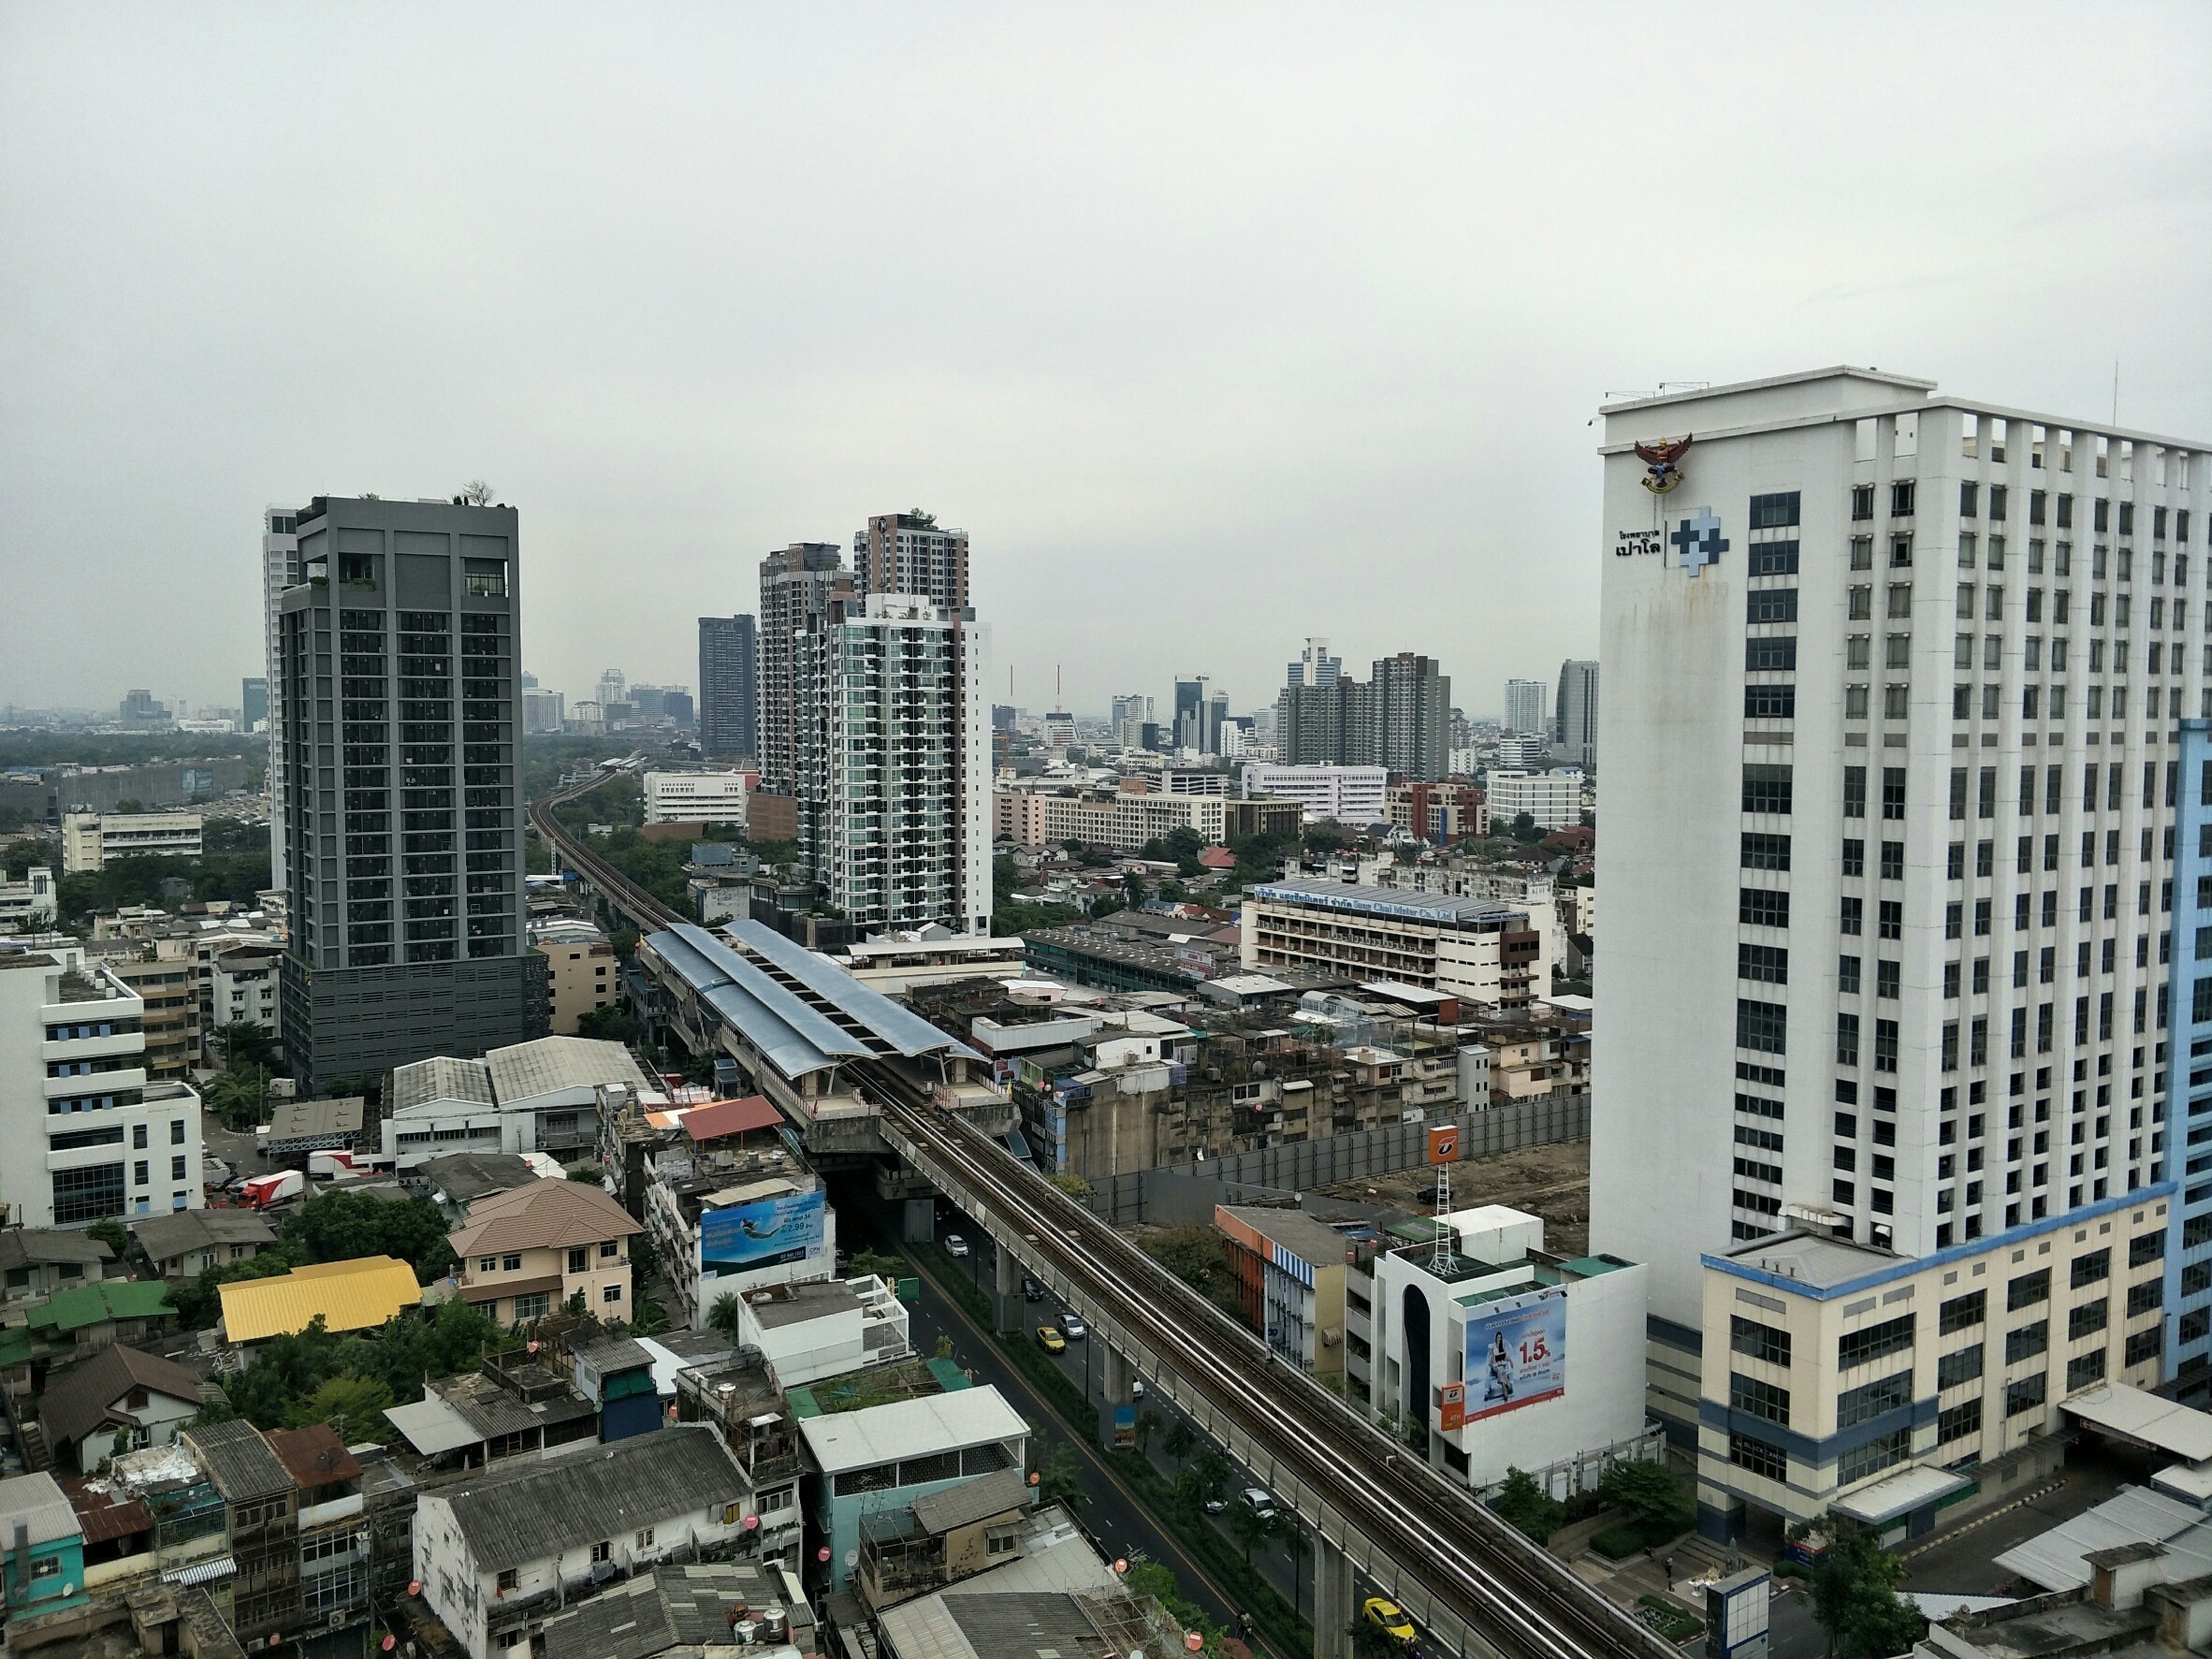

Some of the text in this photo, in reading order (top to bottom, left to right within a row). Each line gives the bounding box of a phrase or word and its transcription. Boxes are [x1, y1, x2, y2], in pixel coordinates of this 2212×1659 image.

[1619, 530, 1660, 540] โรงพยาบาล
[1616, 538, 1661, 556] เปาโล
[1255, 888, 1276, 898] บริษัท
[1331, 897, 1353, 909] จำกัด
[788, 1222, 805, 1233] 2.99
